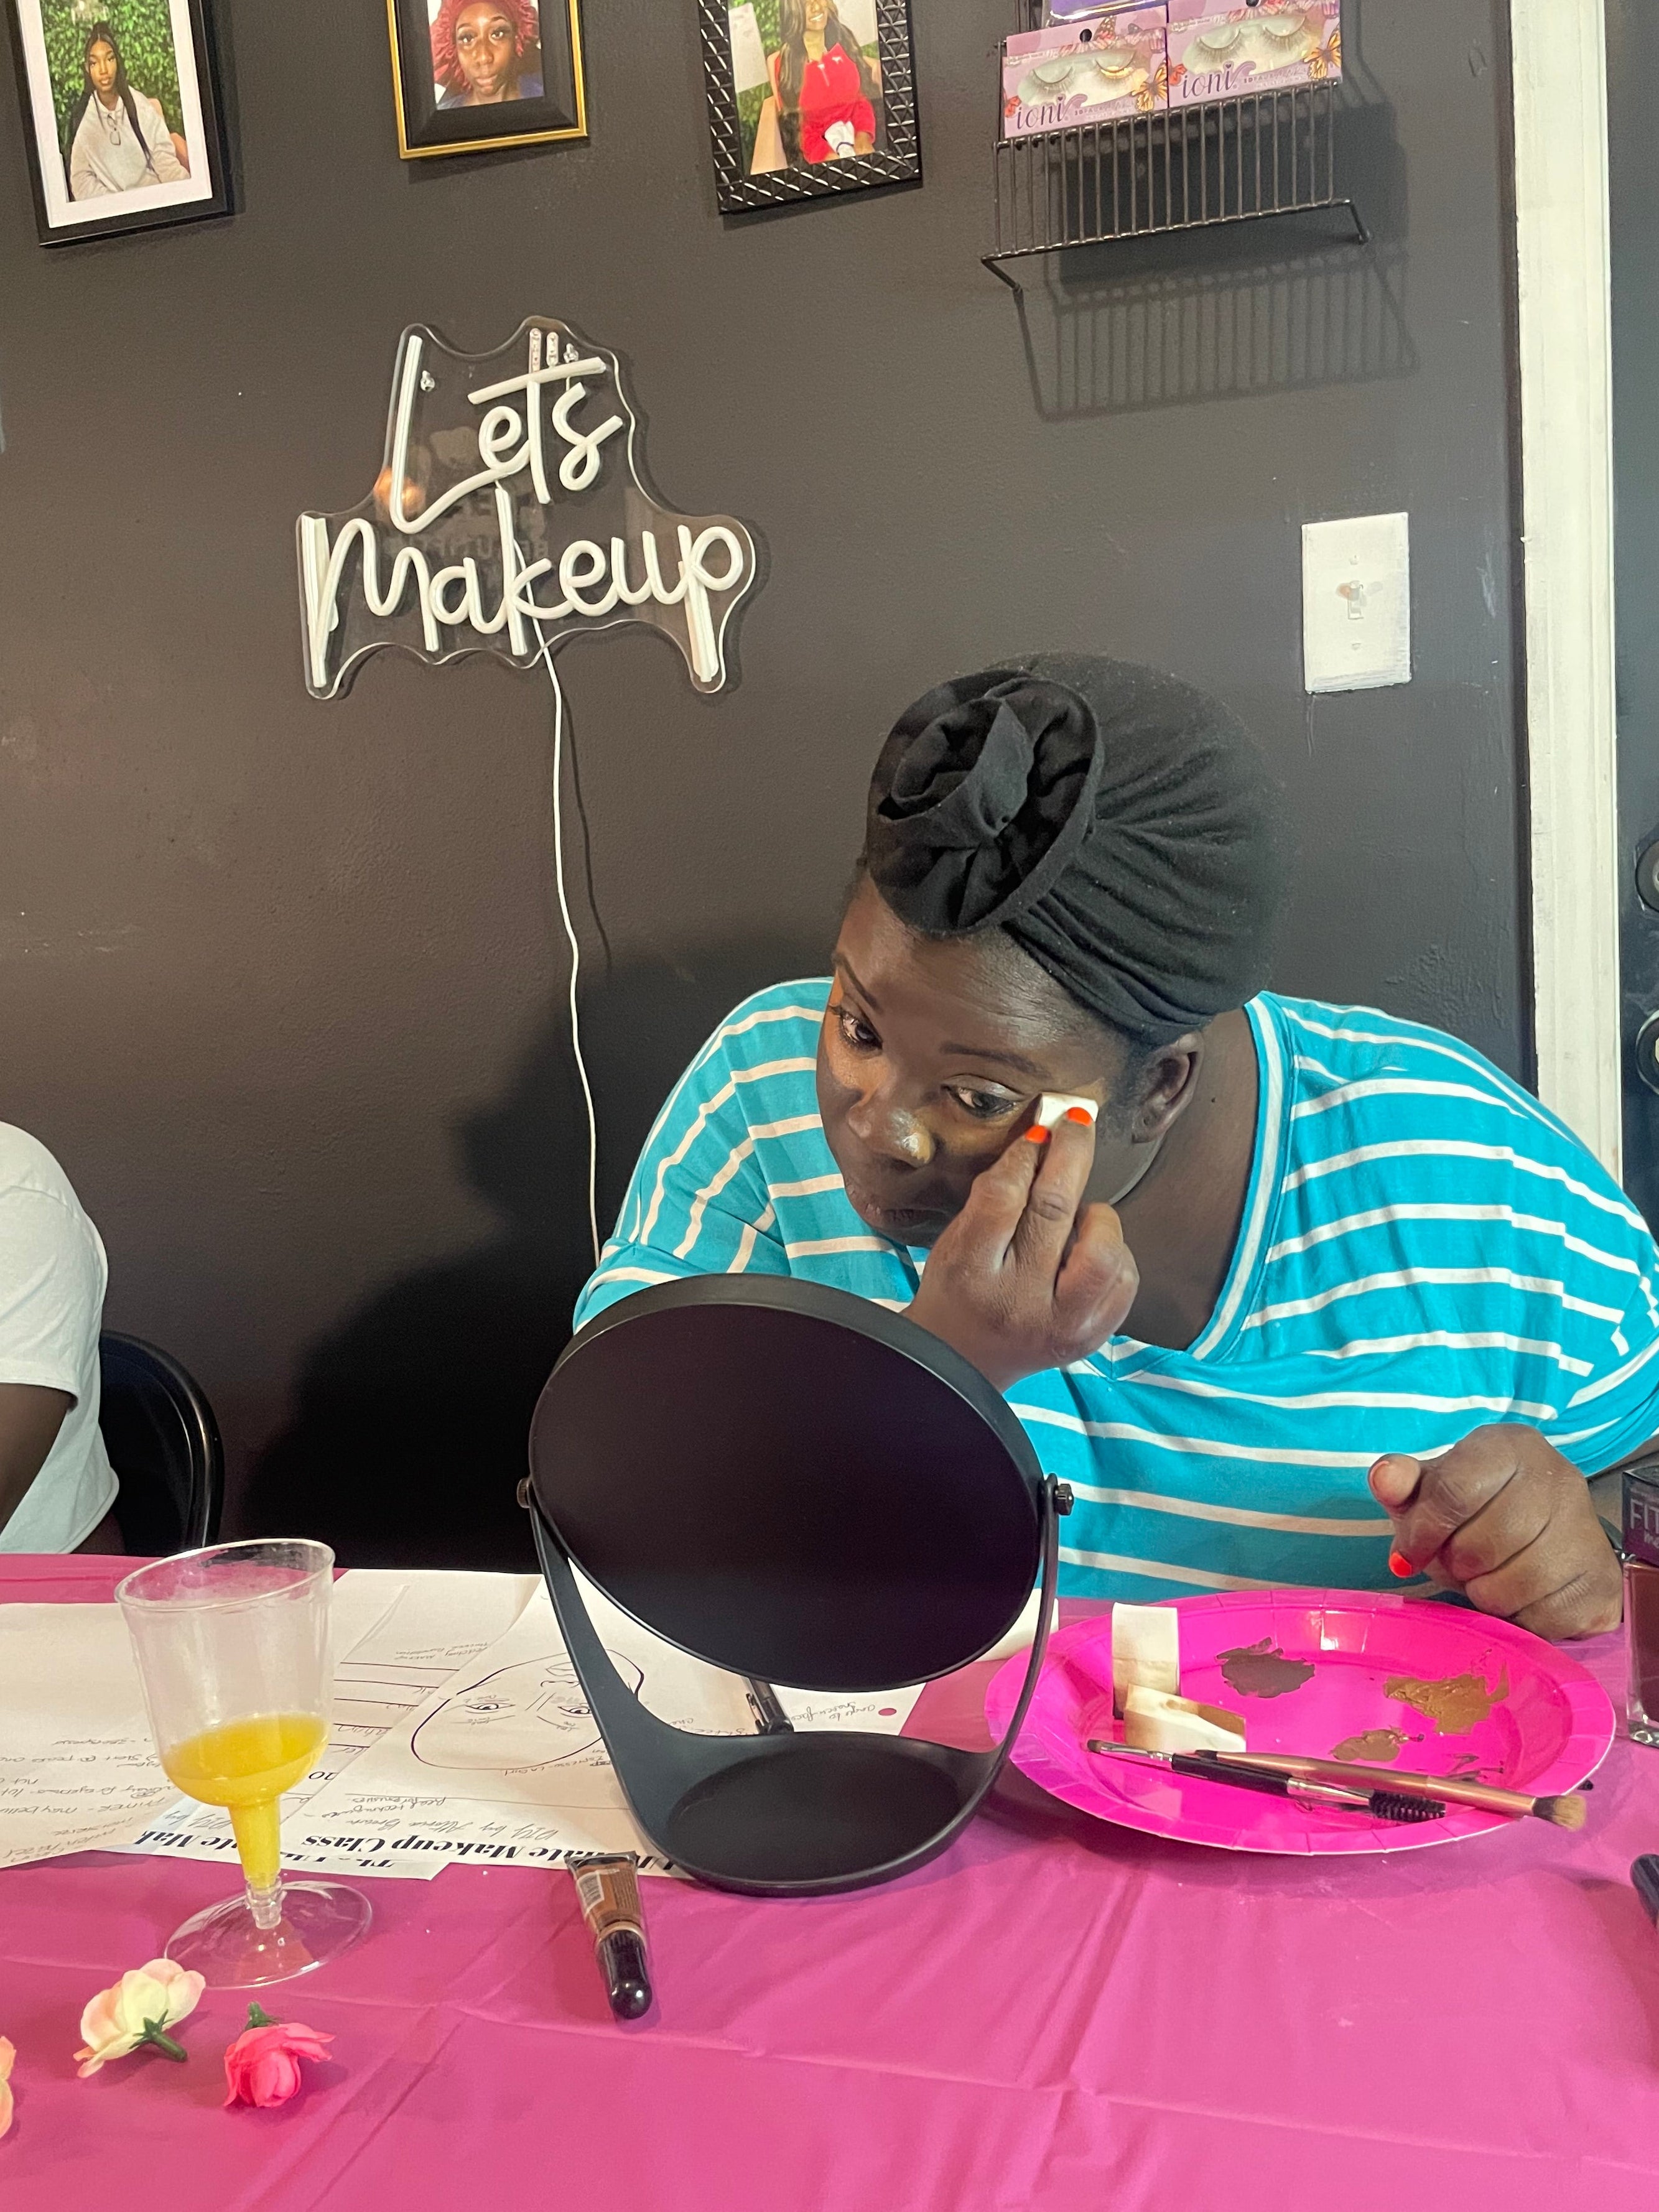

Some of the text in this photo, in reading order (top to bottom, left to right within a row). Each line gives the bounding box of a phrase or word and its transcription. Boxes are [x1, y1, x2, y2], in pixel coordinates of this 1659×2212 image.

[478, 1823, 507, 1838] by
[300, 1835, 386, 1853] Class
[391, 1834, 526, 1859] Makeup
